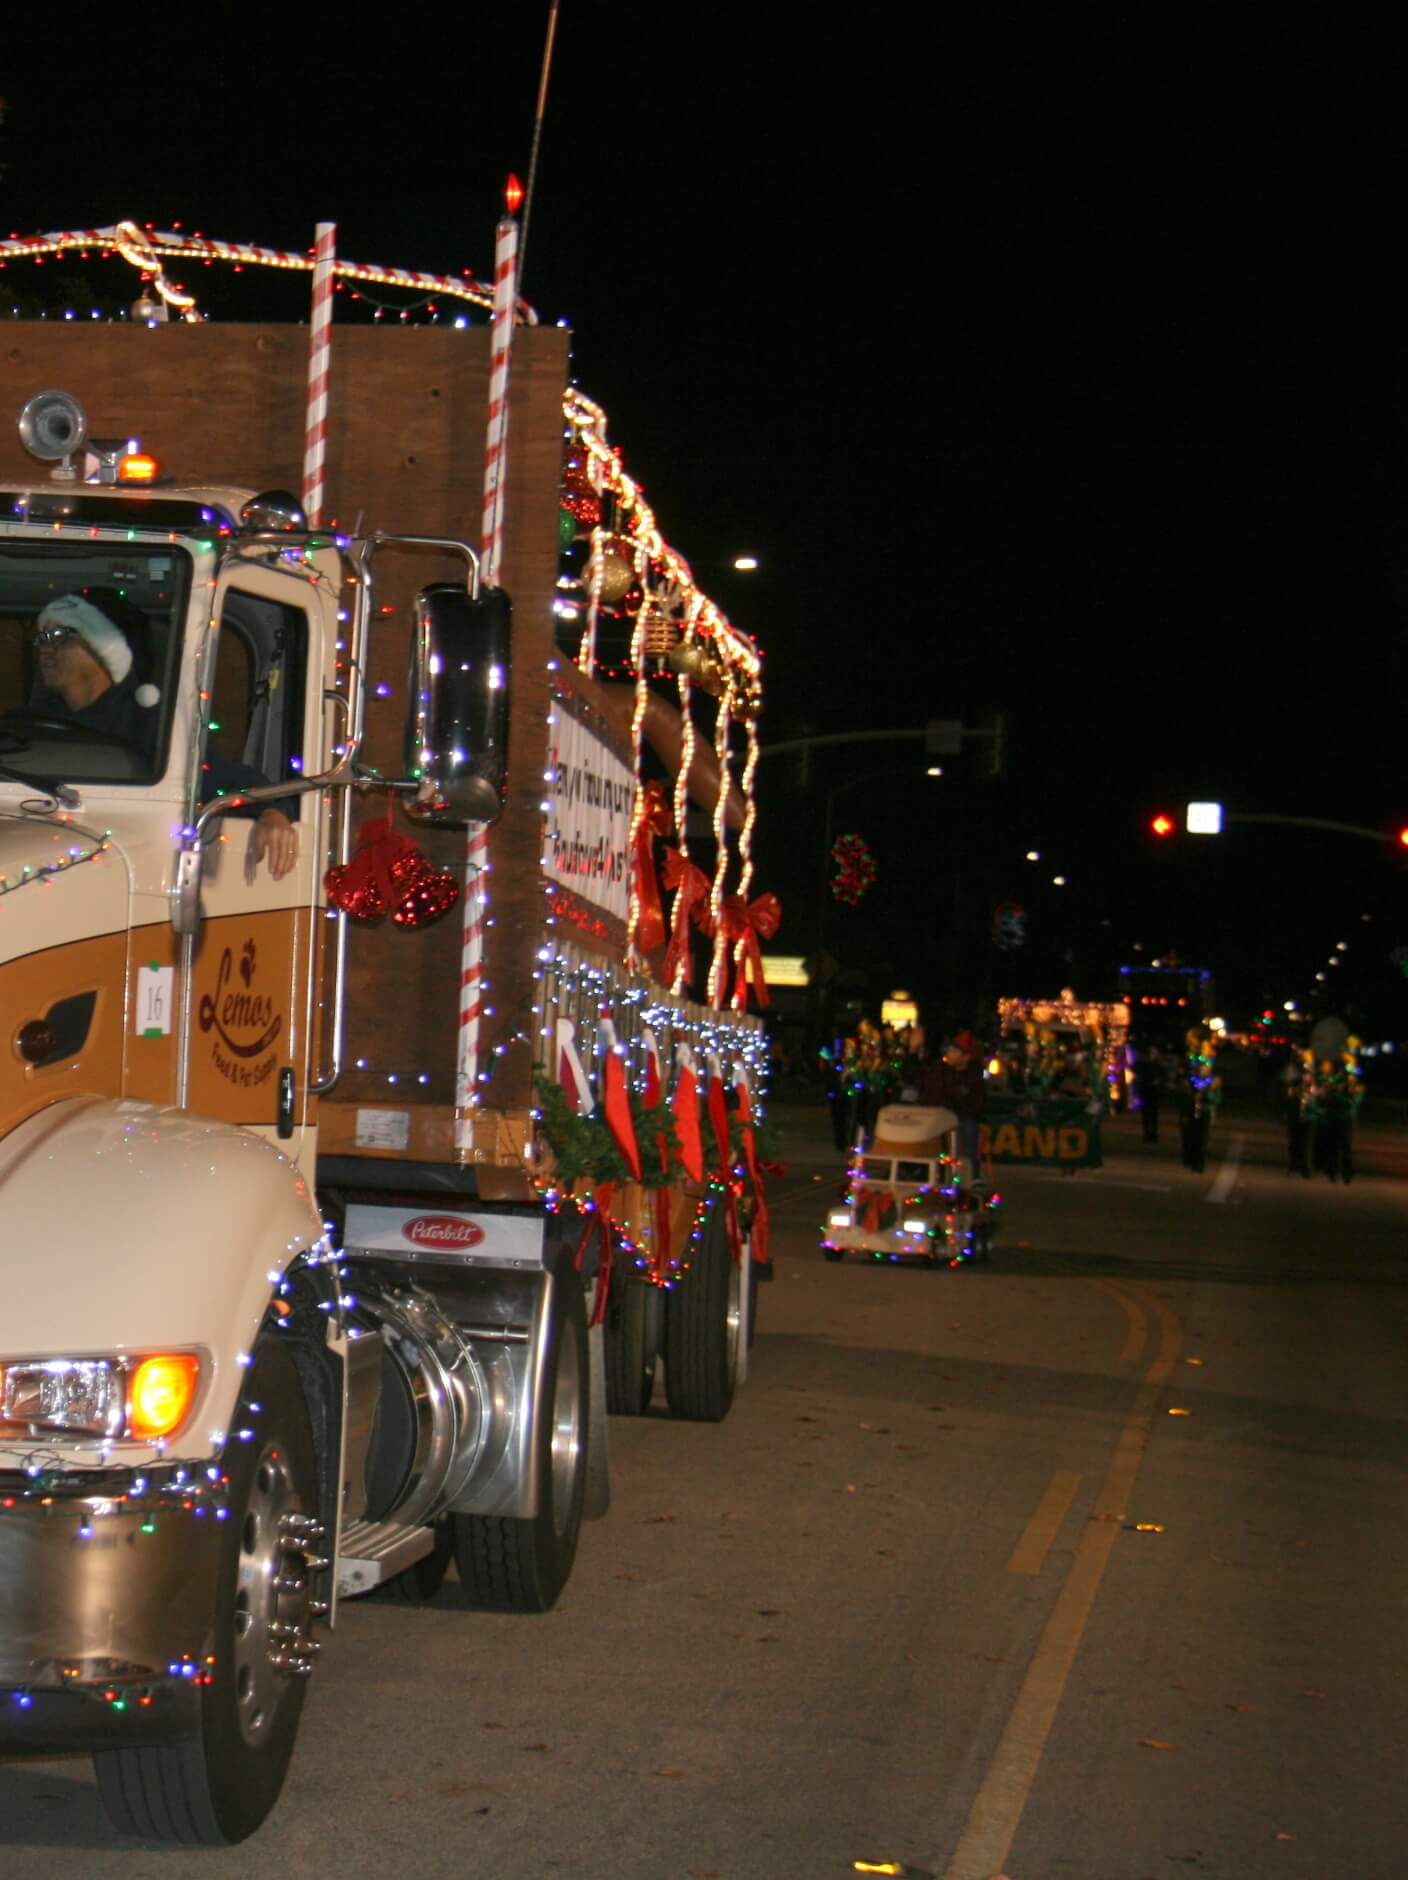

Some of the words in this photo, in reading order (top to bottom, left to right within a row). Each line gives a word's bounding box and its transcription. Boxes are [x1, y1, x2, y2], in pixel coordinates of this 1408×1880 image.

[147, 985, 163, 1021] 16
[200, 947, 282, 1057] Lemos
[412, 1221, 478, 1242] Peterbilt
